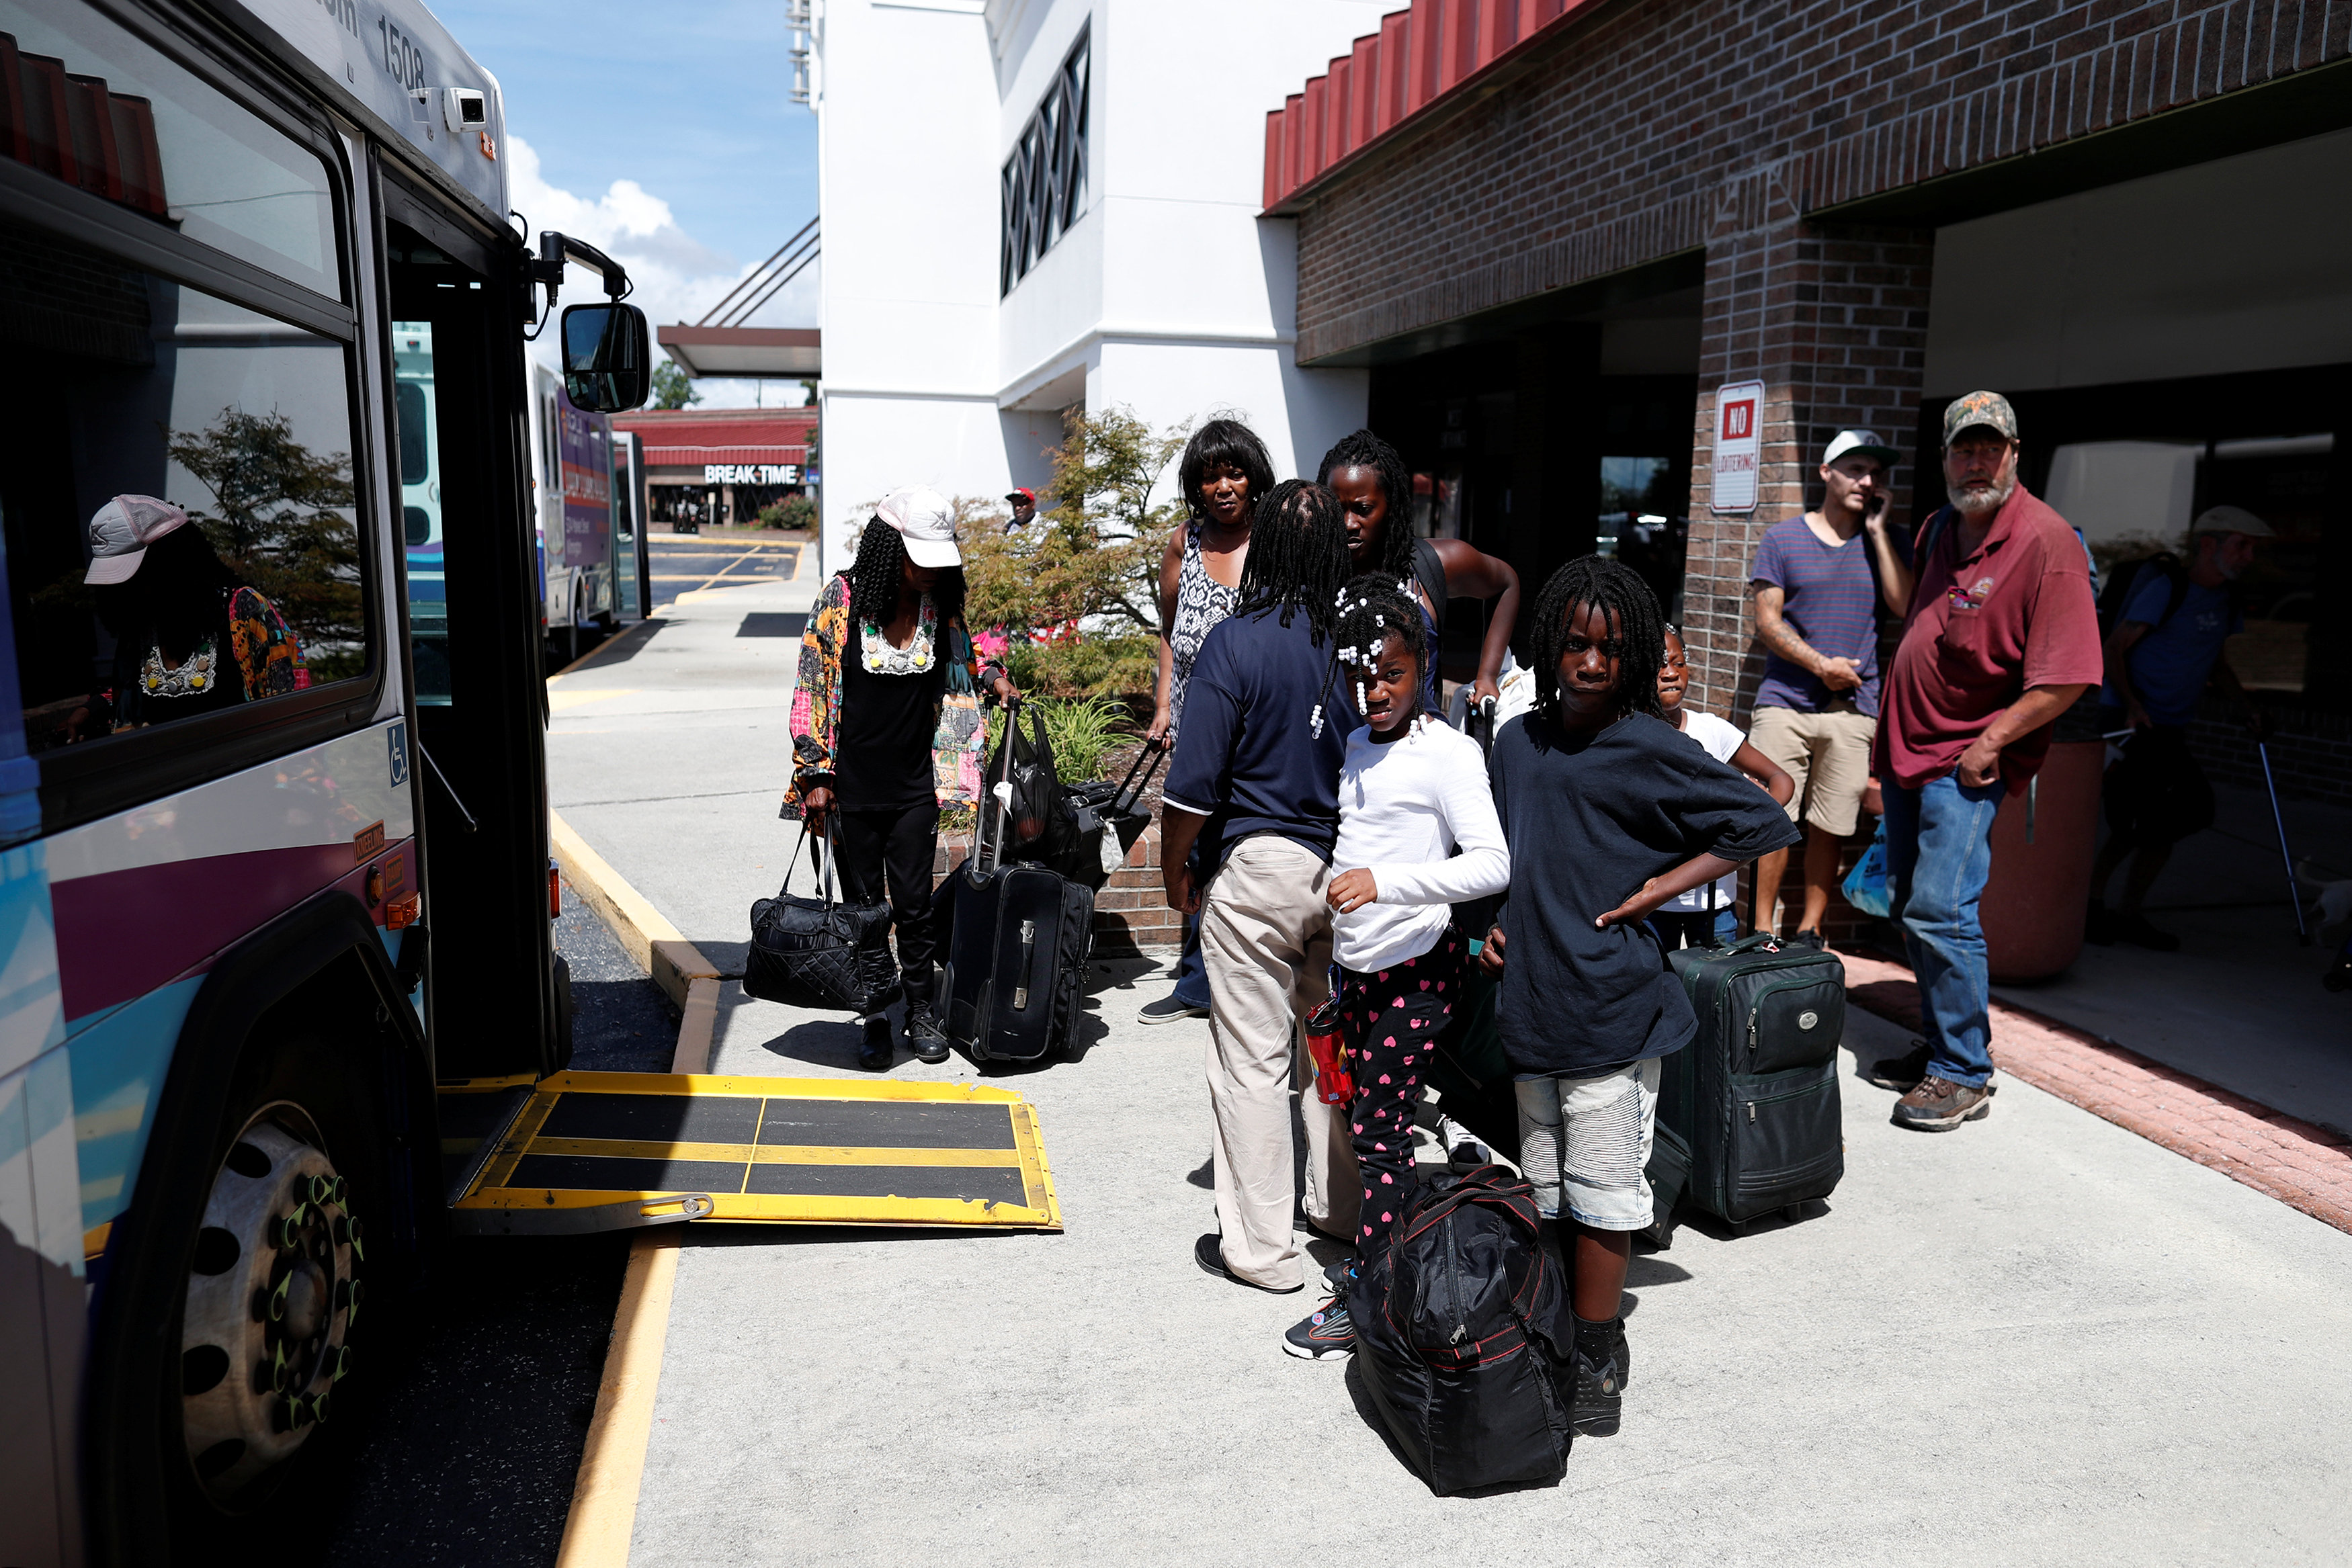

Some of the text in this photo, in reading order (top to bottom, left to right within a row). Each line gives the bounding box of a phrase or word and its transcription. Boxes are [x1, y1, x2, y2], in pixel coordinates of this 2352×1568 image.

[378, 14, 426, 105] 1508
[1728, 405, 1747, 435] NO
[704, 464, 797, 484] BREAK TIME
[355, 826, 384, 859] KNEELING
